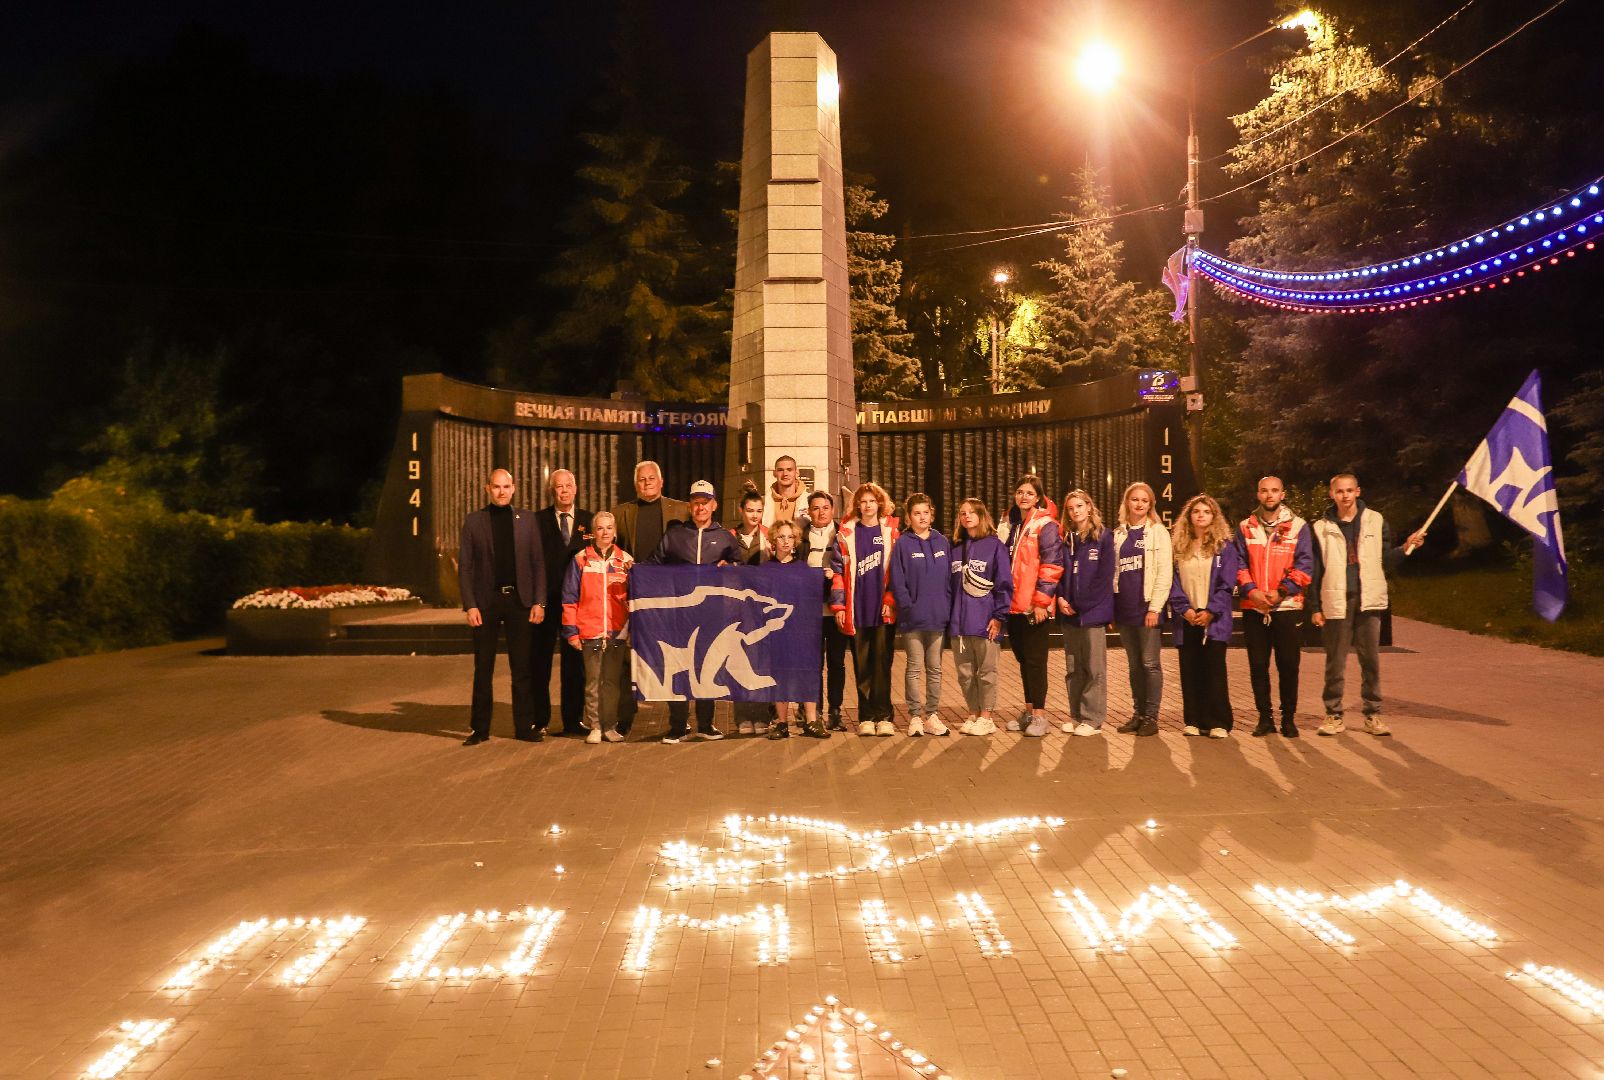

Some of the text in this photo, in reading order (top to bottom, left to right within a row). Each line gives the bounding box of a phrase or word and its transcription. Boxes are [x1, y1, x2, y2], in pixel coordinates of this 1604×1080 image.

[514, 401, 728, 426] ВЕЧНАЯ ПАМЯТЬ ГЕРОЯМ
[408, 432, 421, 536] 1941
